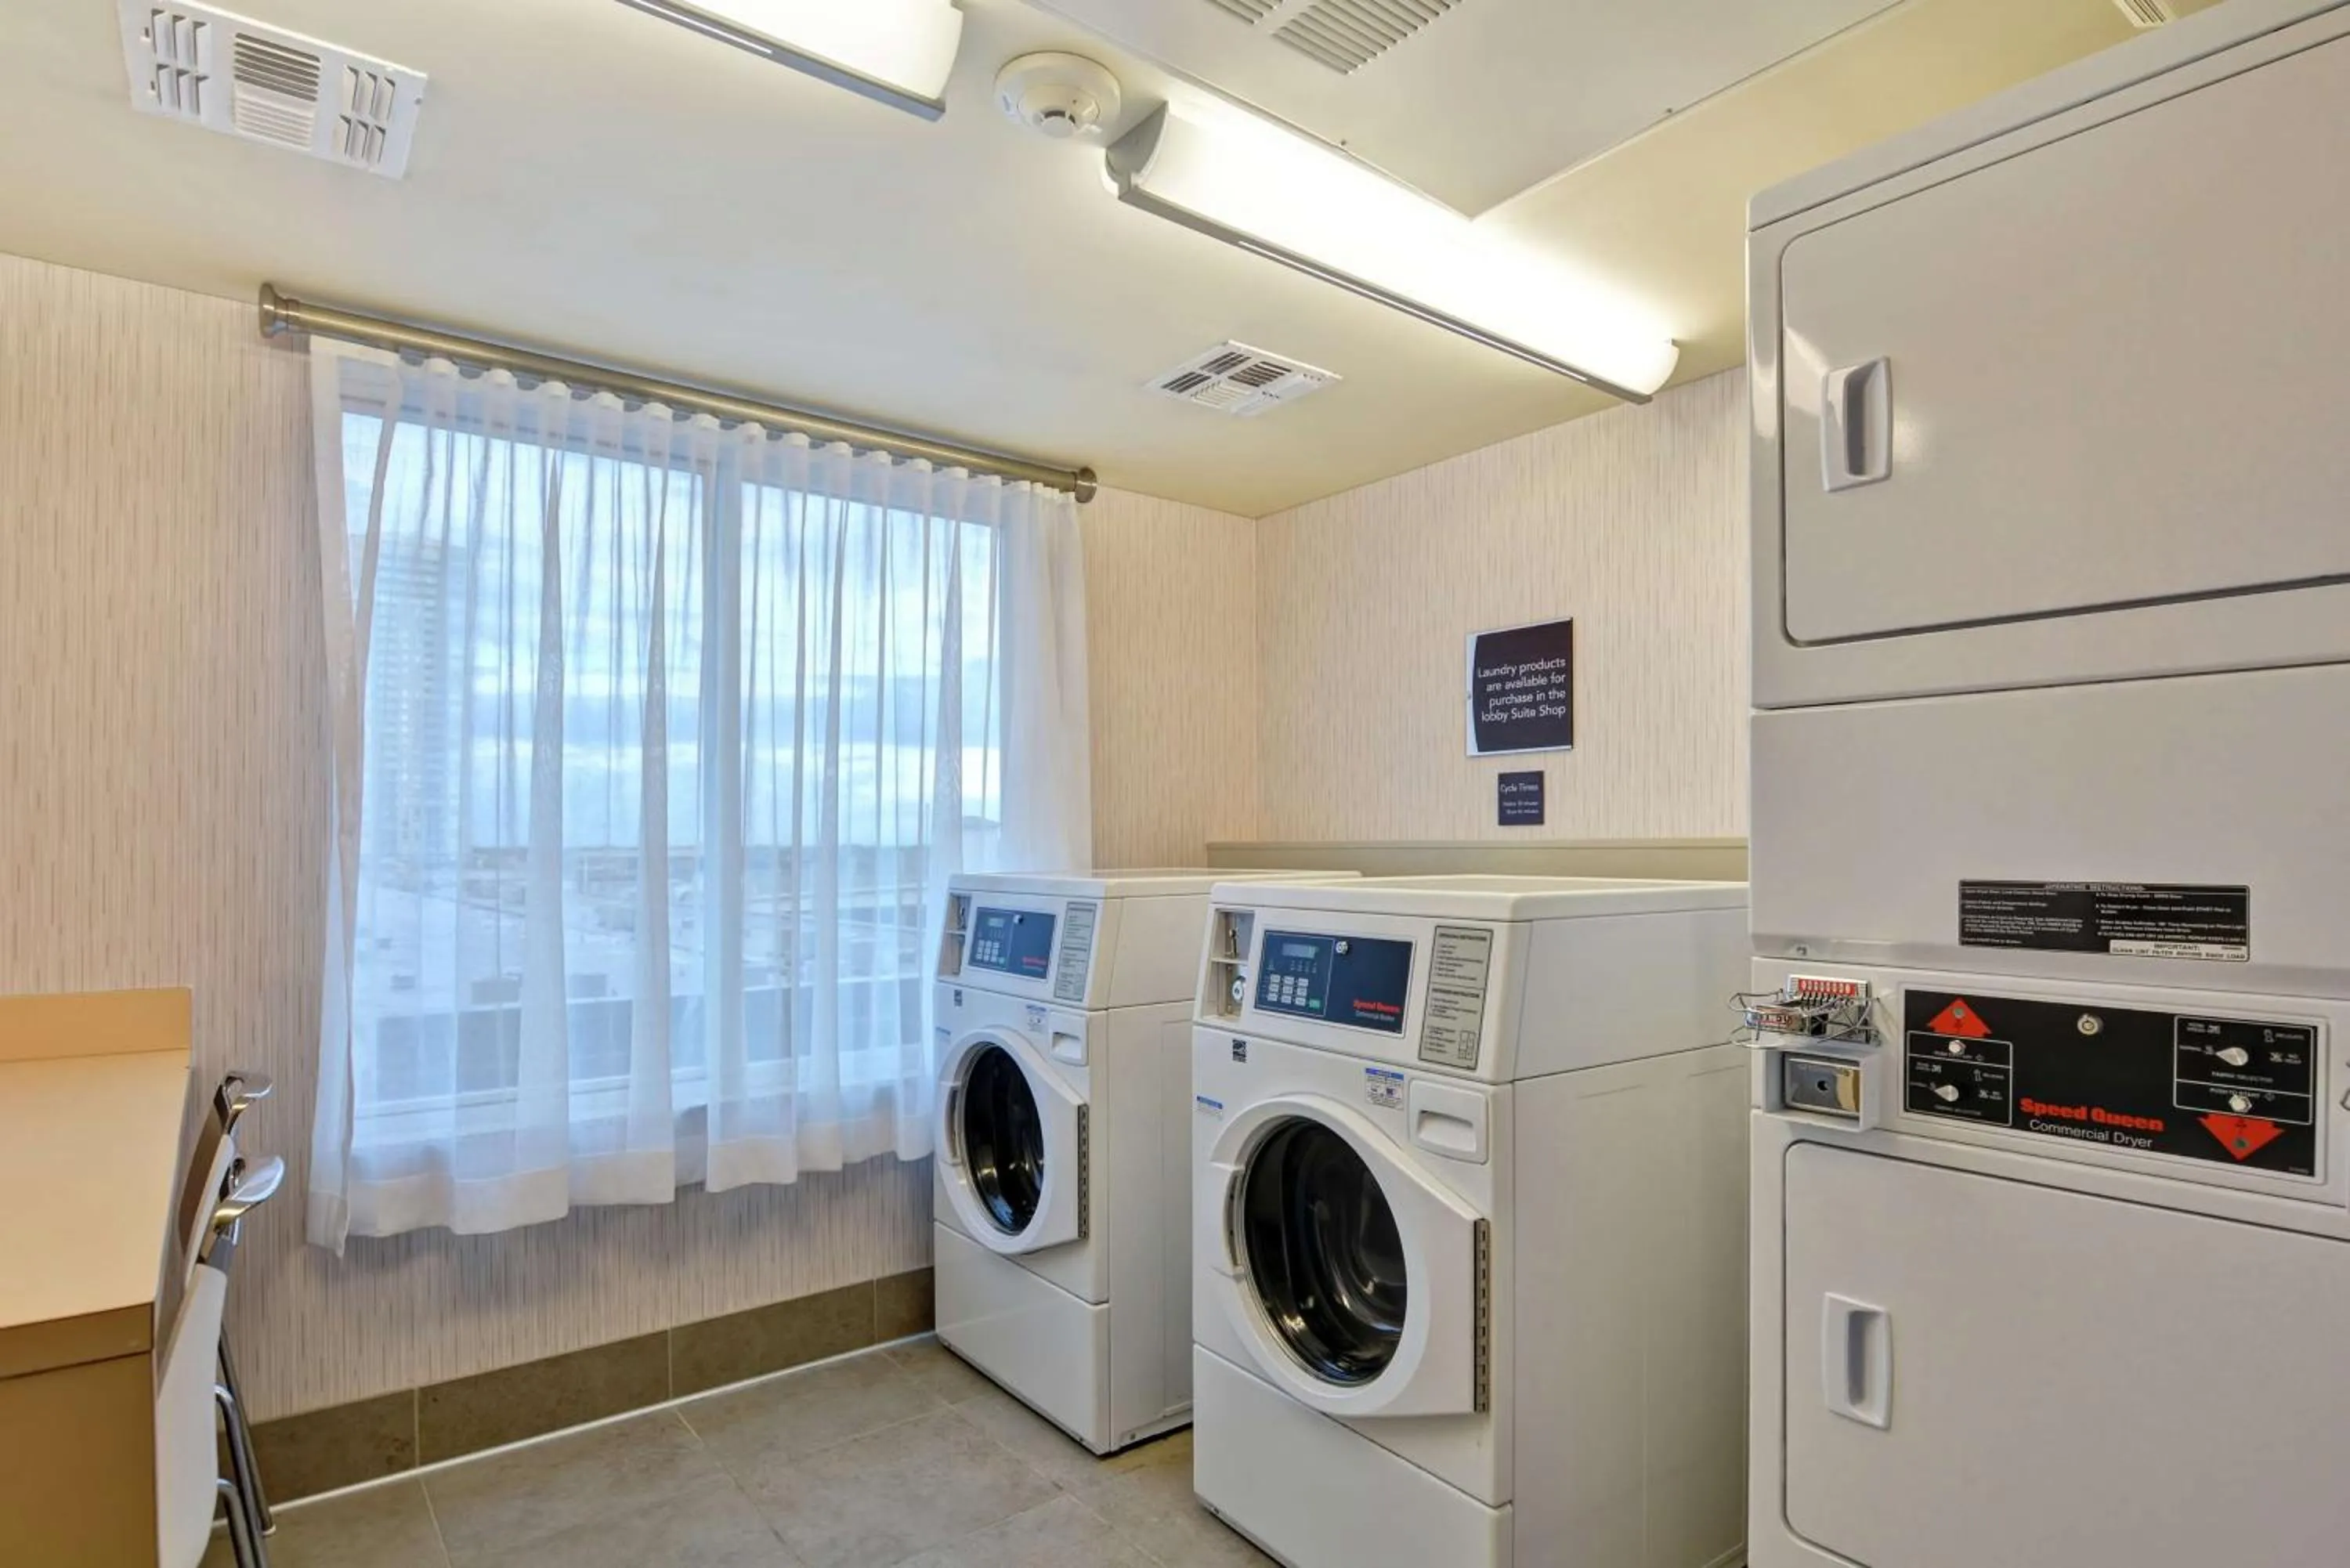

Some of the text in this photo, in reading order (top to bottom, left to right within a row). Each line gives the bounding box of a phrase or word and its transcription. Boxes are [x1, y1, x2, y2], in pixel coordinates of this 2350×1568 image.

[1478, 658, 1566, 677] Laundry products
[1487, 672, 1566, 691] are available for
[1490, 688, 1566, 710] purchase in the
[1482, 703, 1566, 723] lobby Suite Shop
[2020, 1097, 2164, 1131] Speed Queen
[2030, 1119, 2153, 1147] Commercial Dryer
